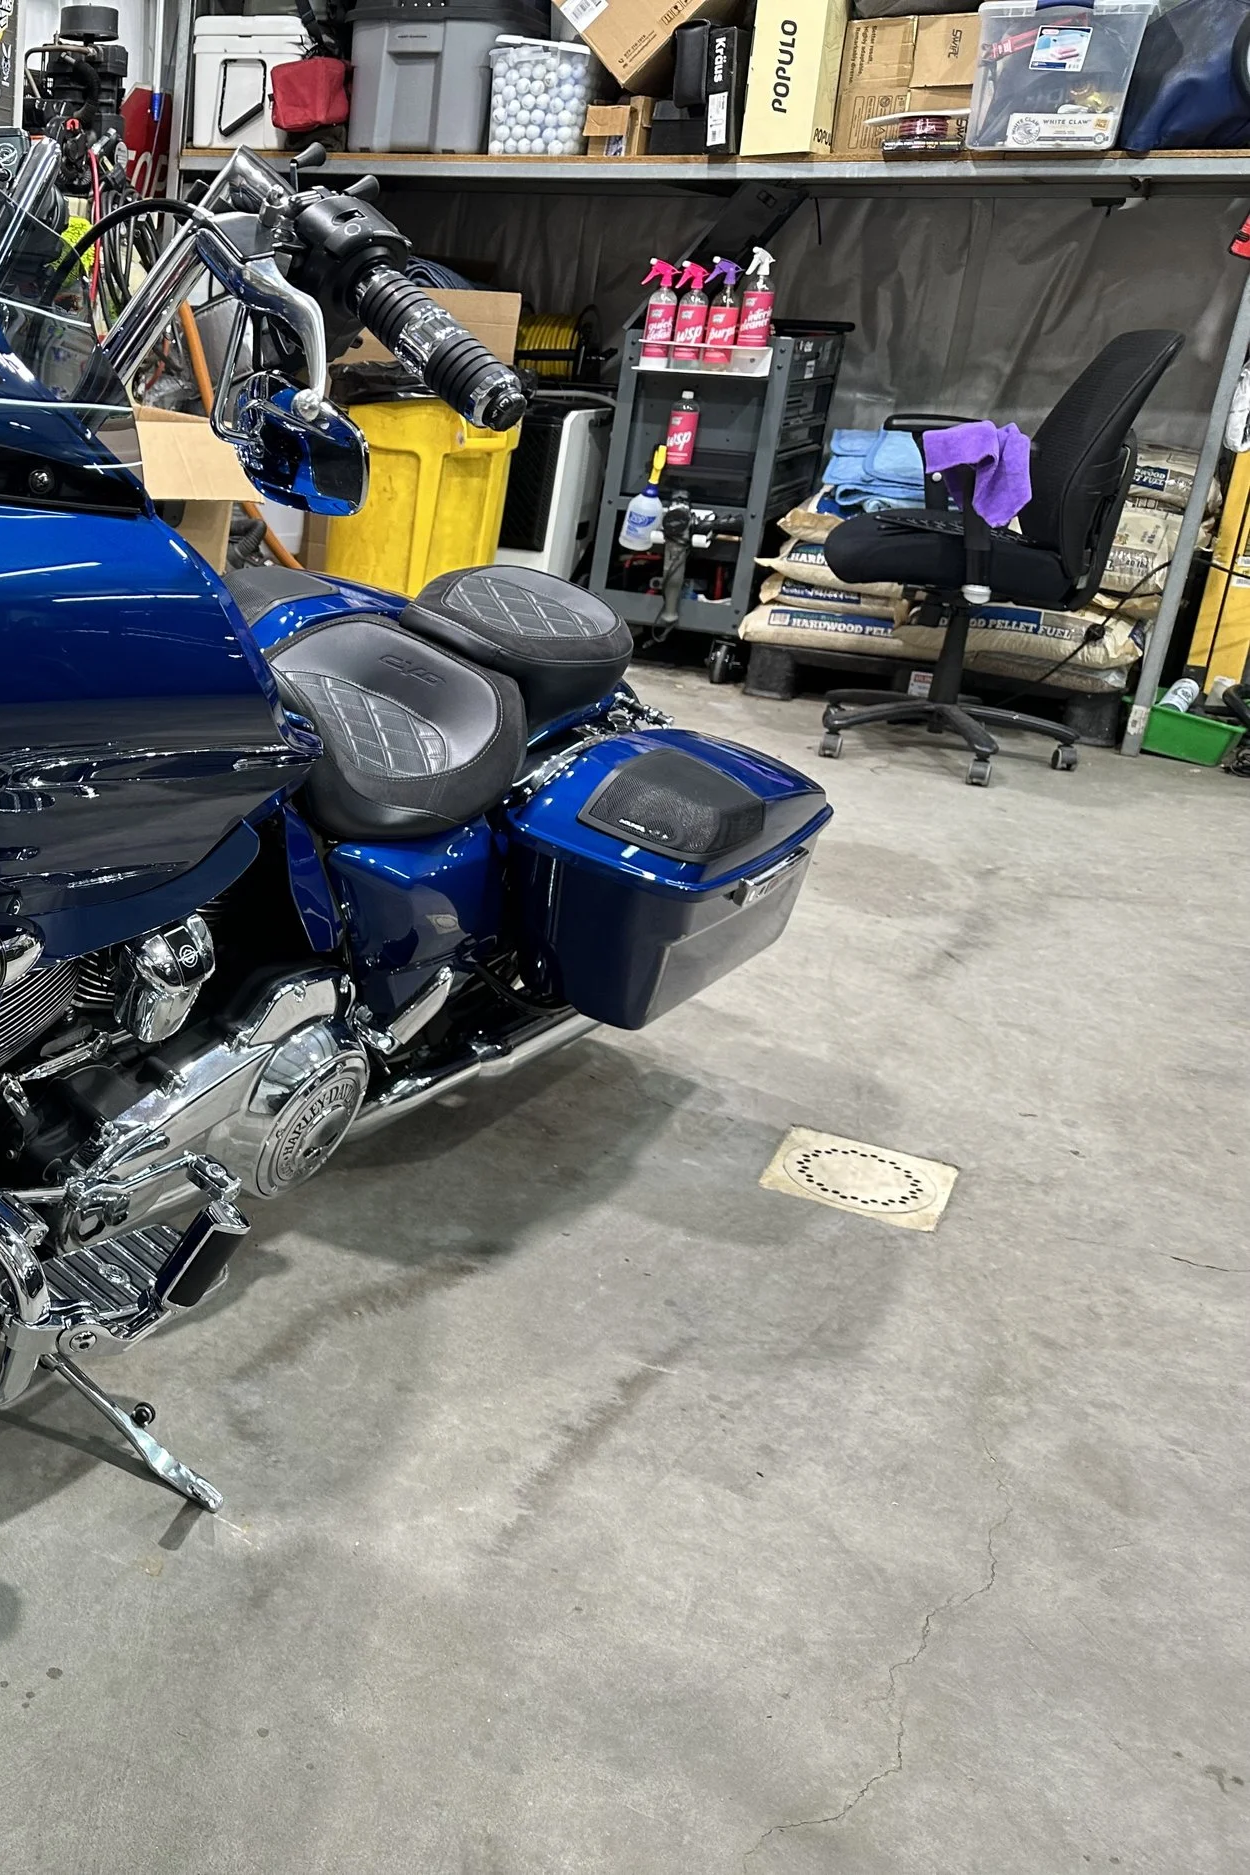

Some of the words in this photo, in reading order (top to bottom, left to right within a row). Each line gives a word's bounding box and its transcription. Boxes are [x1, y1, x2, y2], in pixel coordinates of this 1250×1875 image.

[714, 37, 727, 83] Kräus
[771, 20, 798, 114] POPULO
[677, 325, 703, 344] wsp
[667, 431, 692, 451] wsp
[792, 618, 863, 635] HARDWOOD
[988, 619, 1037, 634] PELLET
[1038, 625, 1071, 640] FUEL
